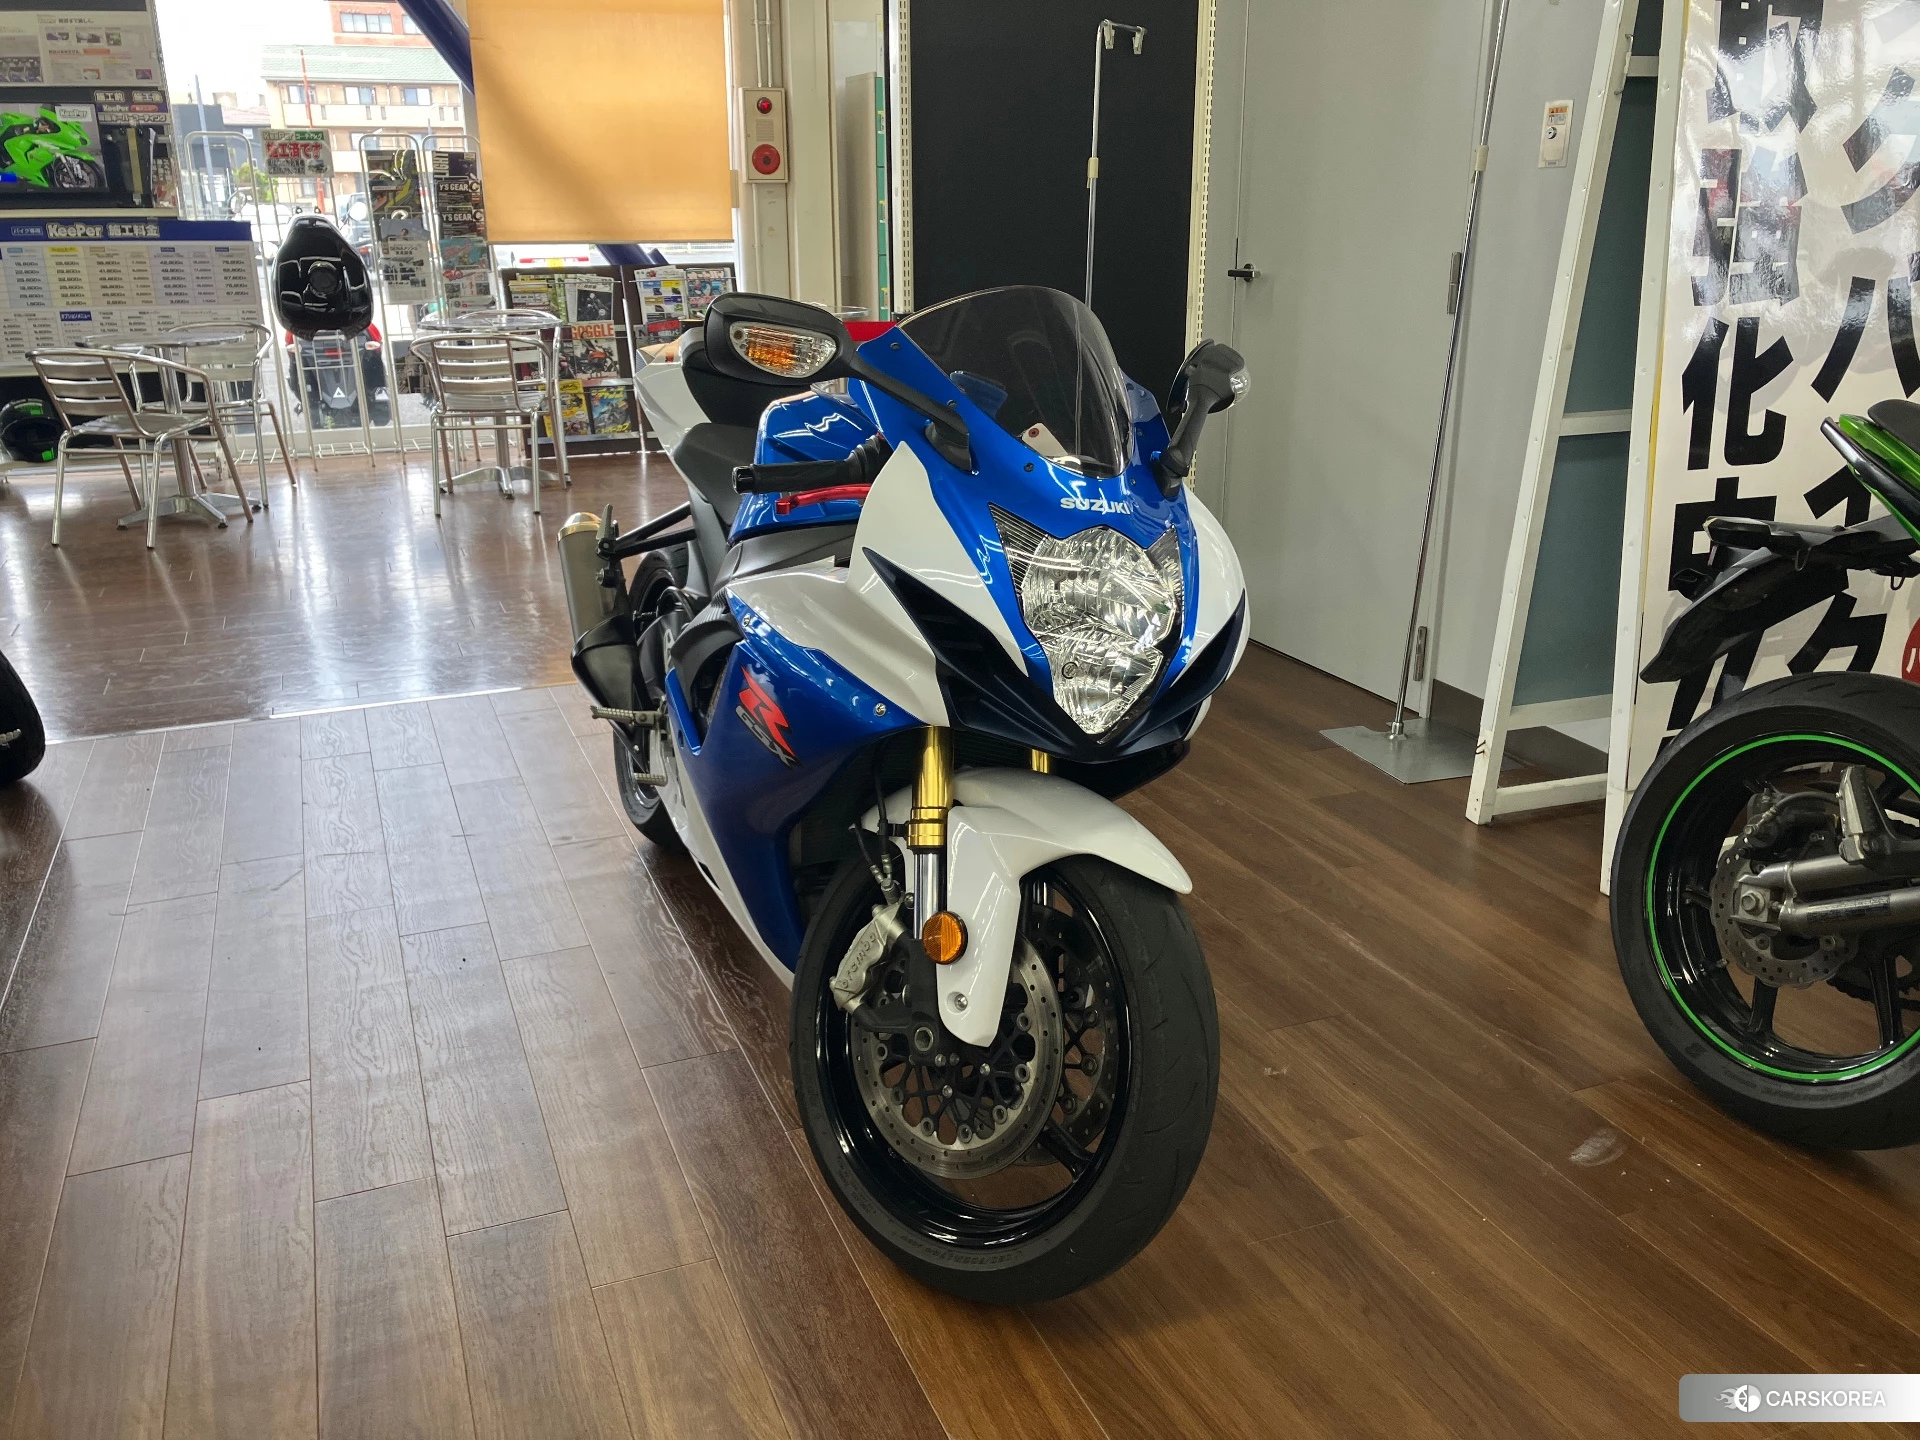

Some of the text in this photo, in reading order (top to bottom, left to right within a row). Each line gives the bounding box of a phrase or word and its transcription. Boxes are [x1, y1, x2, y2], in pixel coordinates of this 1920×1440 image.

[266, 142, 323, 159] 施工済です
[450, 183, 469, 191] GEAR
[453, 213, 472, 221] GEAR
[46, 223, 103, 238] KeePer
[107, 223, 160, 237] 施工料金
[572, 323, 614, 339] GOGGLE
[1060, 497, 1131, 515] SUZUKI
[841, 932, 877, 989] brembo
